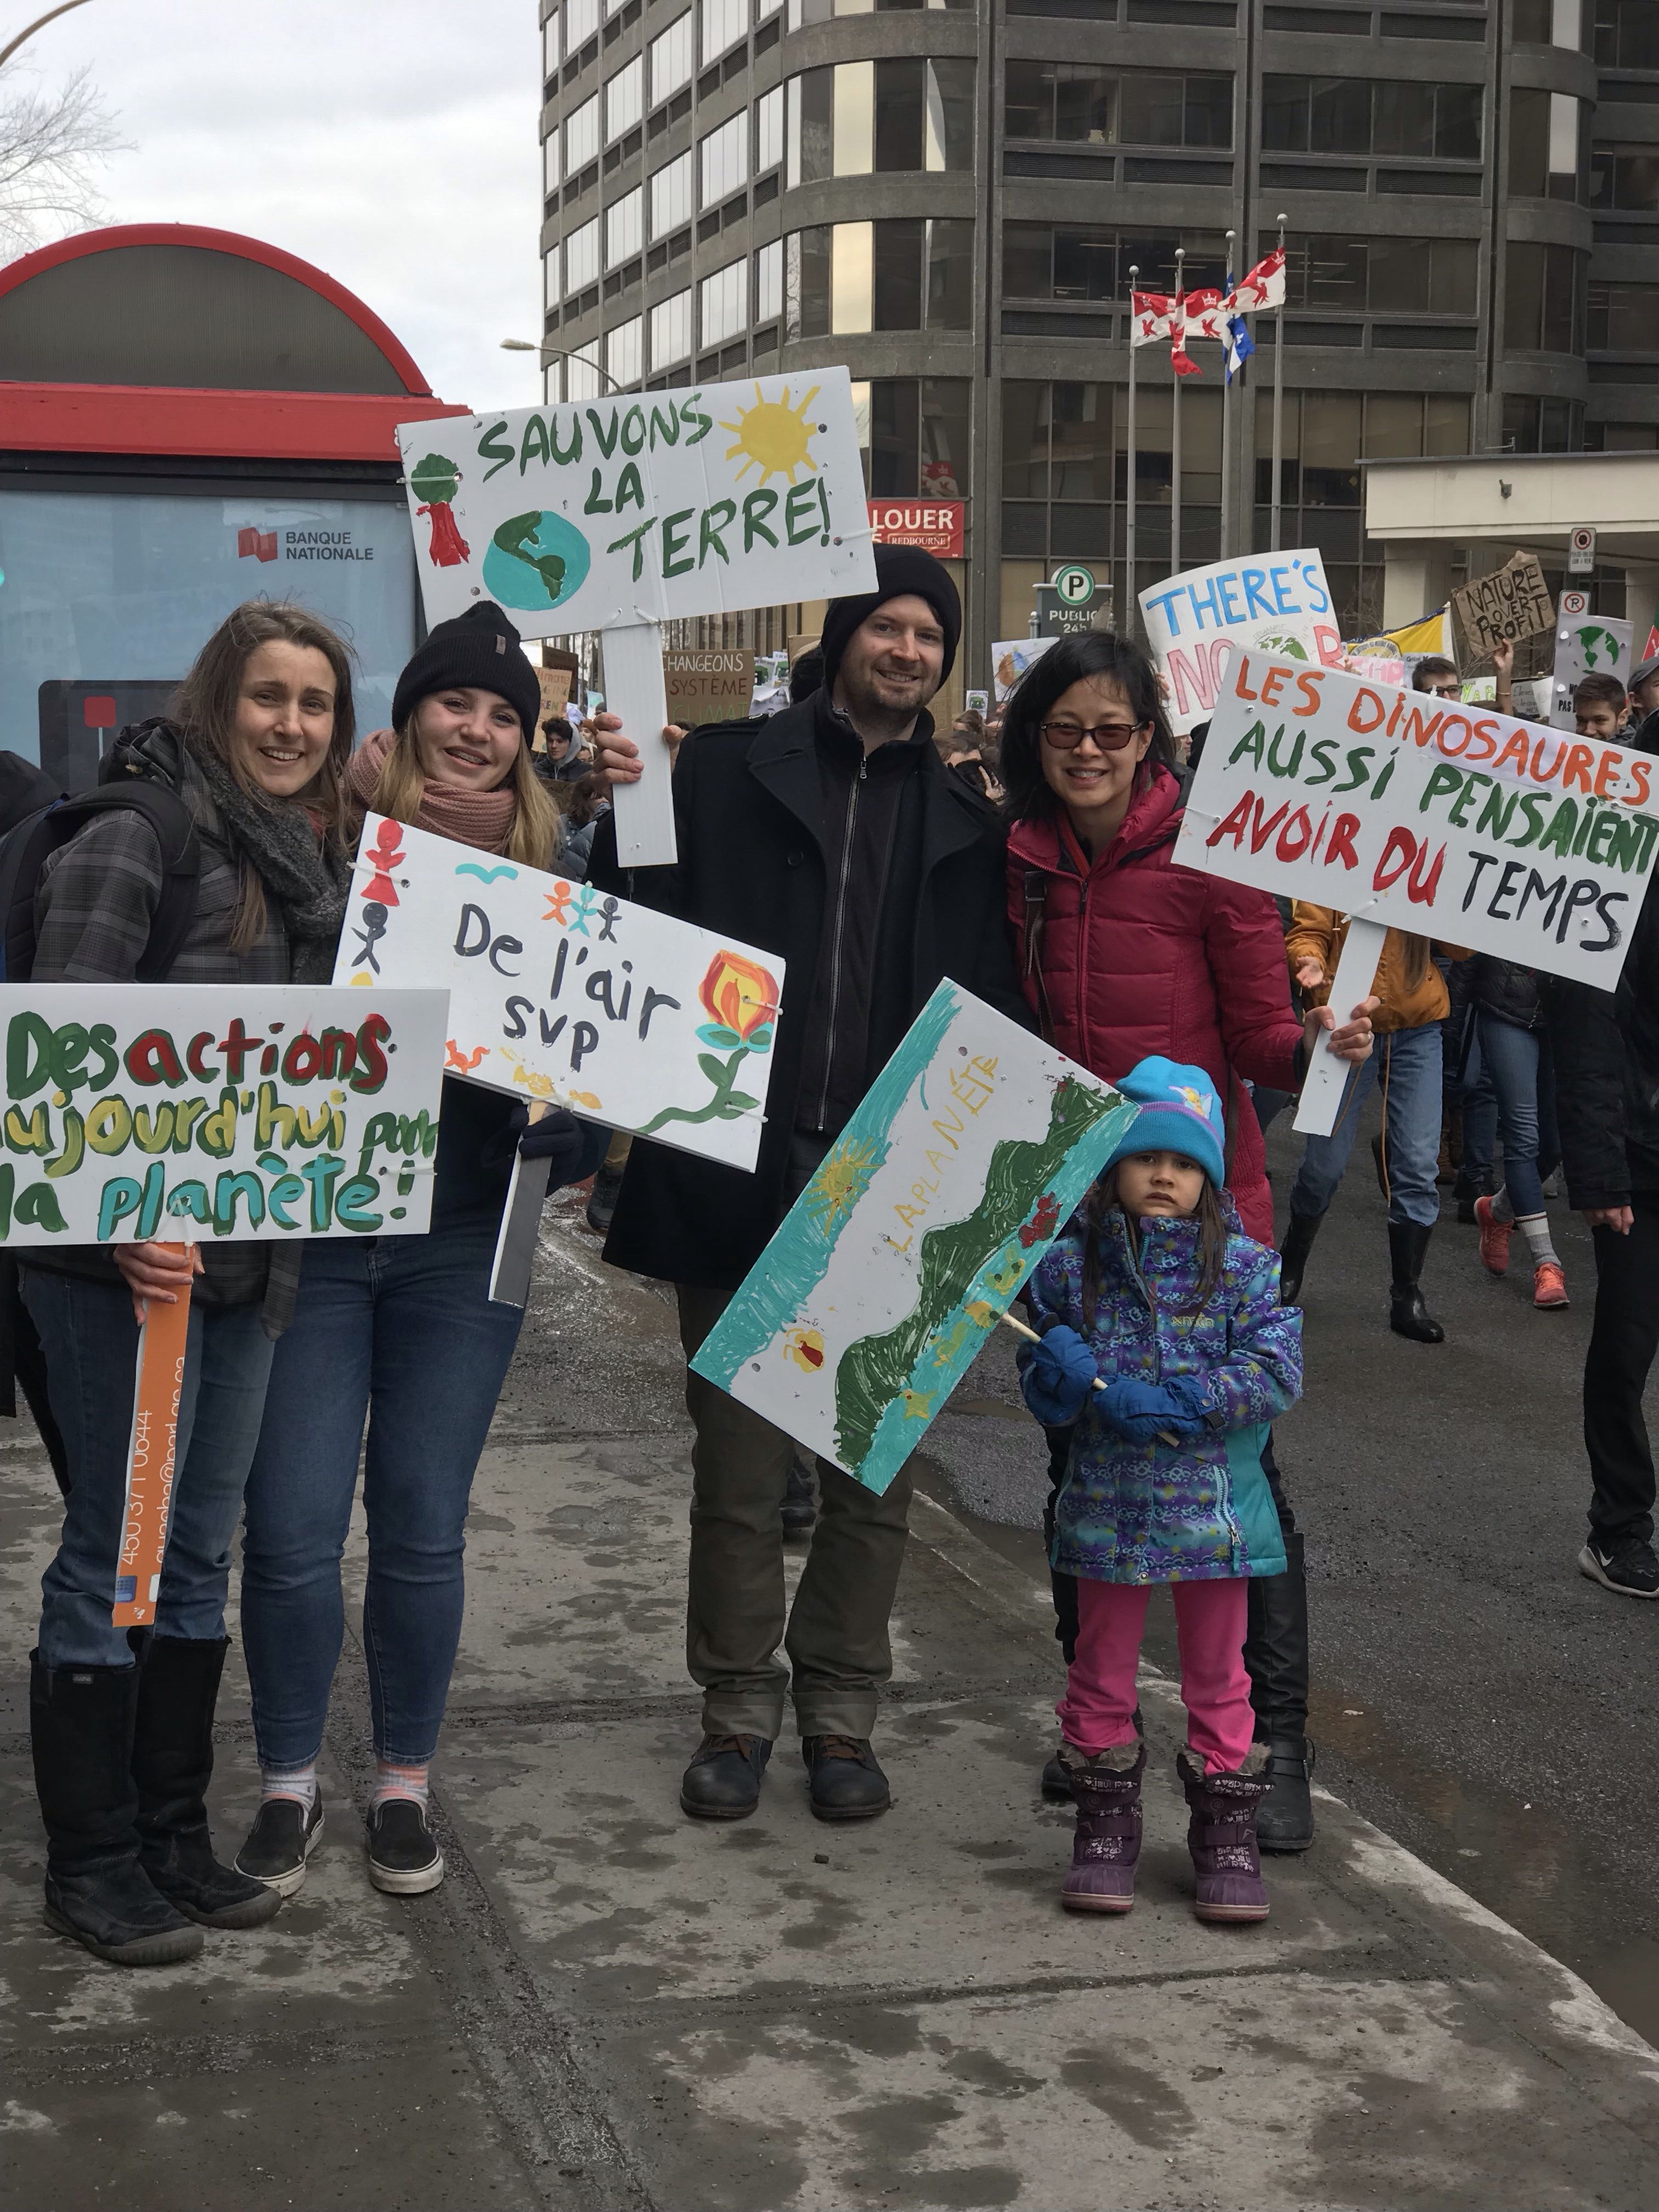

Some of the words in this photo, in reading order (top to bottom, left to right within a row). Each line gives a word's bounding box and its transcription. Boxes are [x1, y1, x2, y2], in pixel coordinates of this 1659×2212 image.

[478, 393, 713, 482] SAUVONS
[584, 462, 645, 515] LA
[286, 531, 352, 545] BANQUE
[606, 477, 831, 582] TERRE!
[872, 509, 953, 529] LOUER
[891, 537, 946, 545] REDBOURNE
[286, 547, 374, 561] NATIONALE
[1146, 558, 1329, 637] THERE'S
[1466, 563, 1543, 618] NATURE
[1492, 596, 1532, 623] OVER
[1476, 593, 1549, 647] PROFIT
[670, 674, 747, 696] SYSTÈME
[1235, 655, 1325, 716] LES
[1559, 699, 1571, 712] PAS
[1373, 826, 1447, 907] DU
[1462, 851, 1629, 952] TEMPS
[453, 904, 523, 977] De
[550, 937, 681, 1042] l'air
[7, 1011, 119, 1100] Des
[123, 1013, 391, 1094] actions
[0, 1080, 347, 1178] ujourd'hui
[0, 1163, 69, 1242] la
